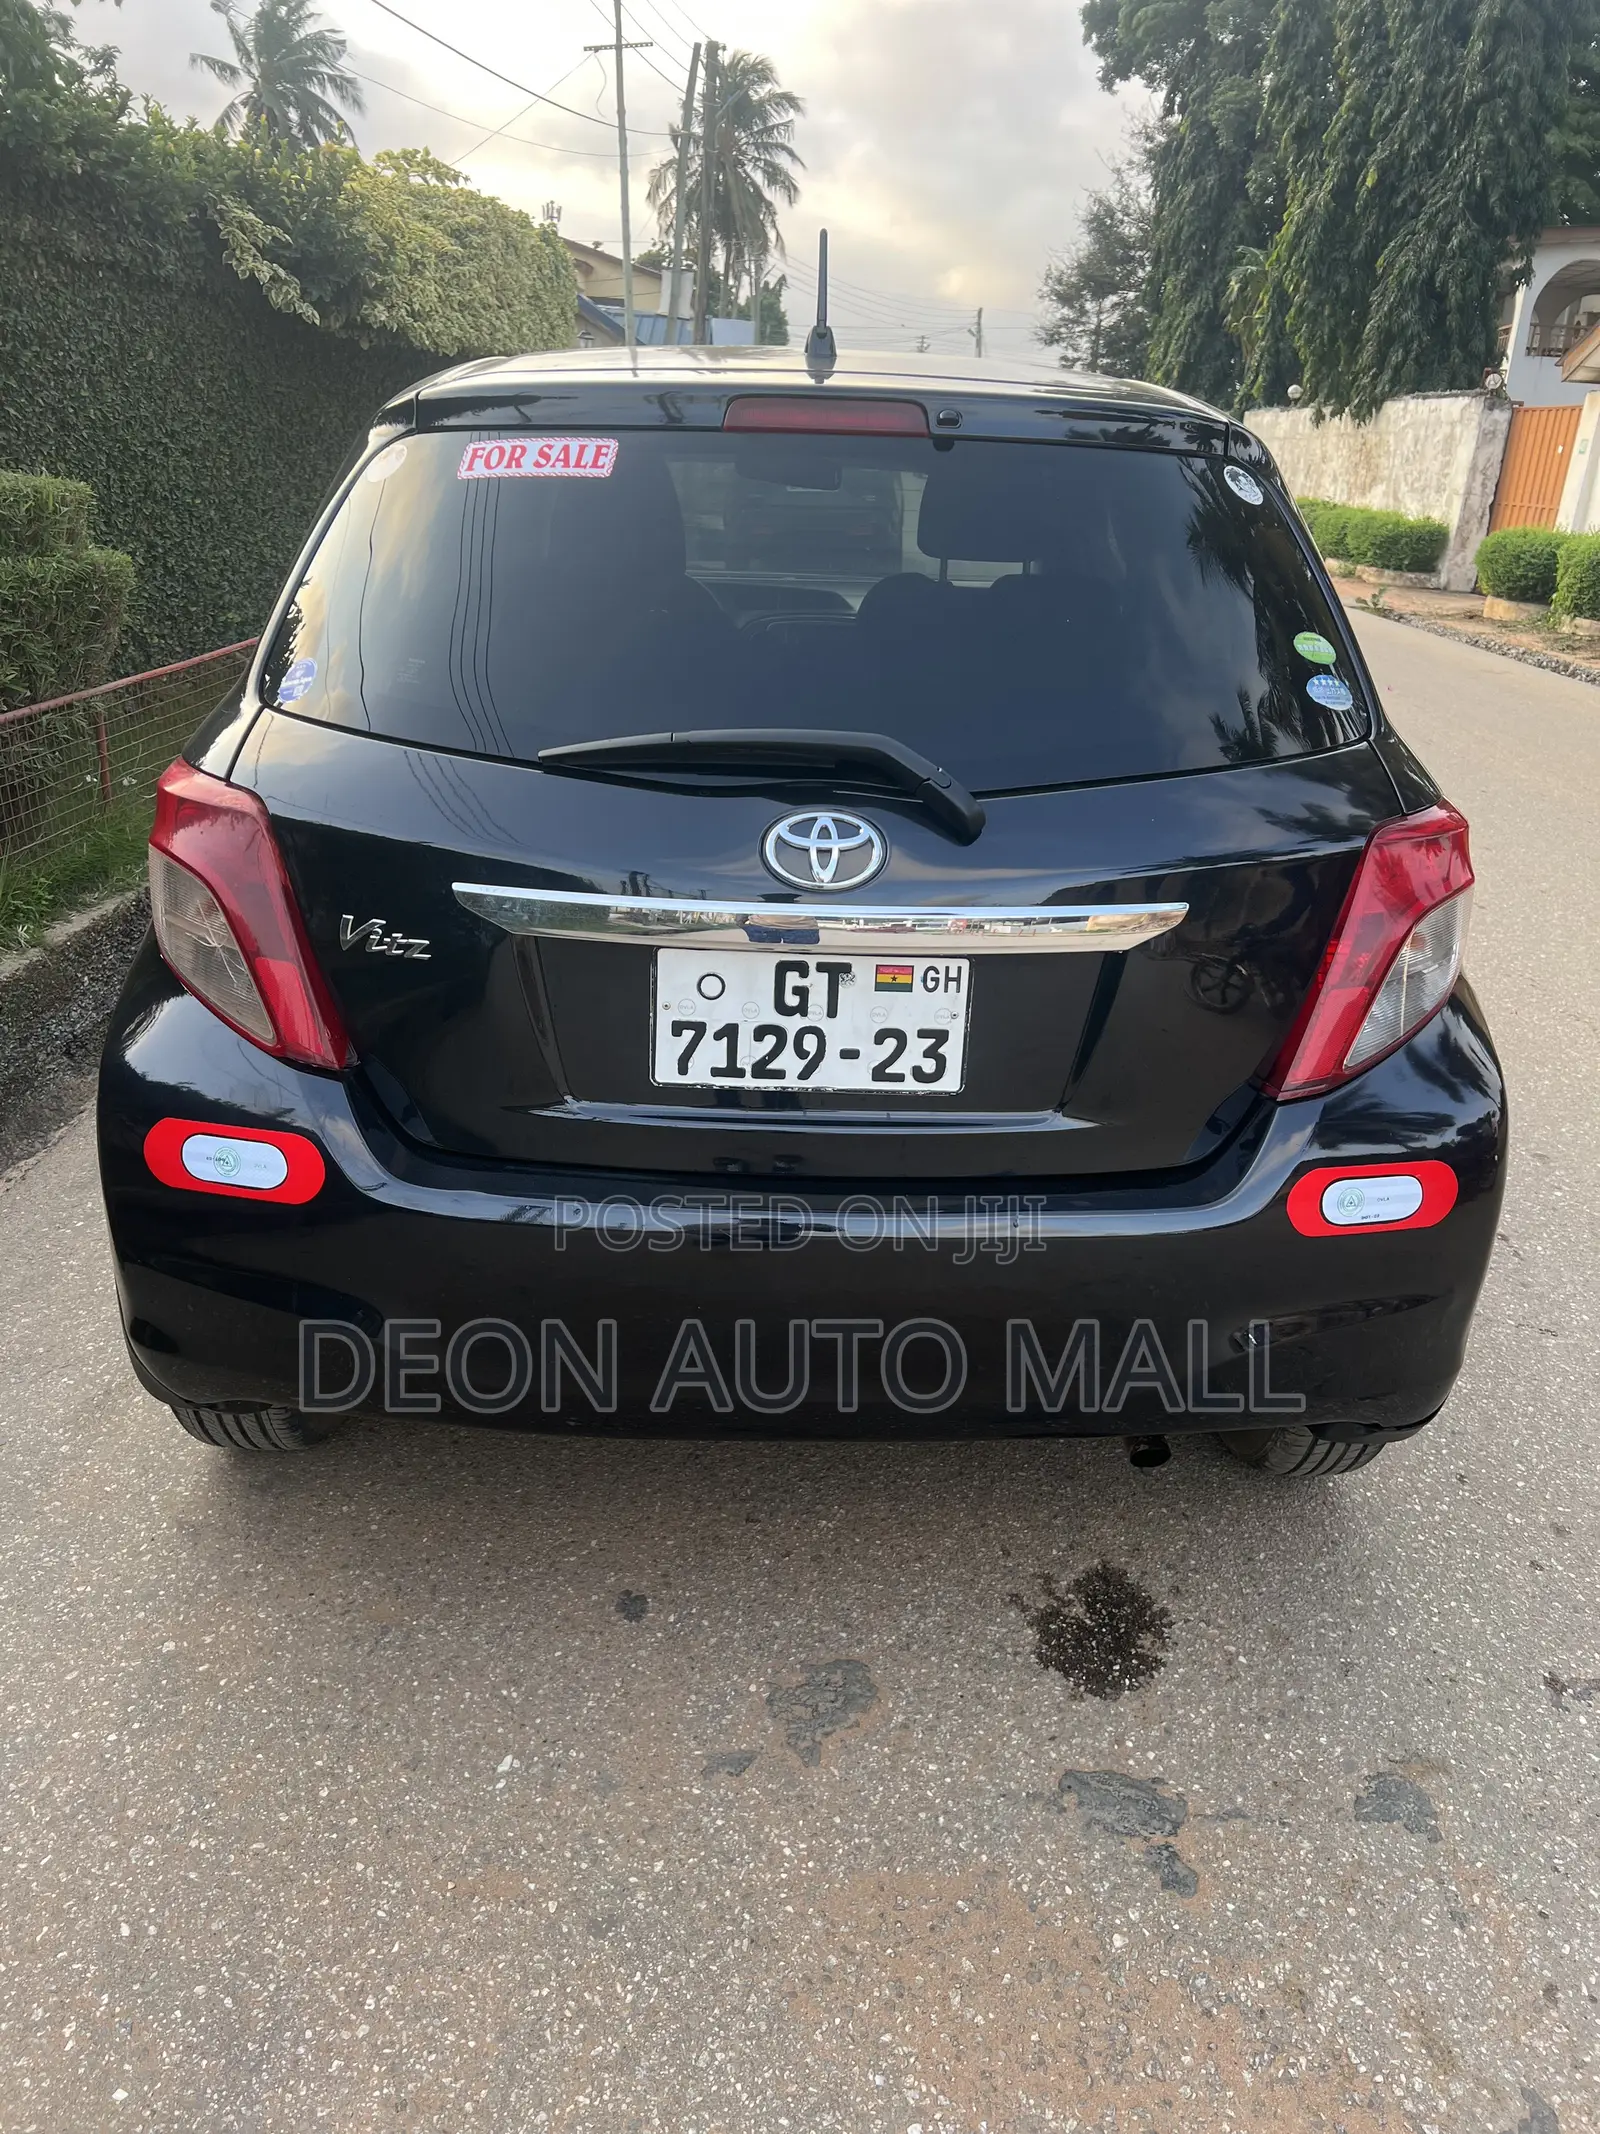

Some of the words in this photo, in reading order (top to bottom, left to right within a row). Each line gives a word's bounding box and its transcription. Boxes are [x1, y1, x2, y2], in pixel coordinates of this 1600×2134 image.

[465, 444, 527, 472] FOR
[533, 443, 611, 470] SALE
[340, 914, 432, 960] Vitz
[774, 960, 853, 1018] GT
[922, 965, 962, 993] GH
[671, 1020, 950, 1083] 7129-23
